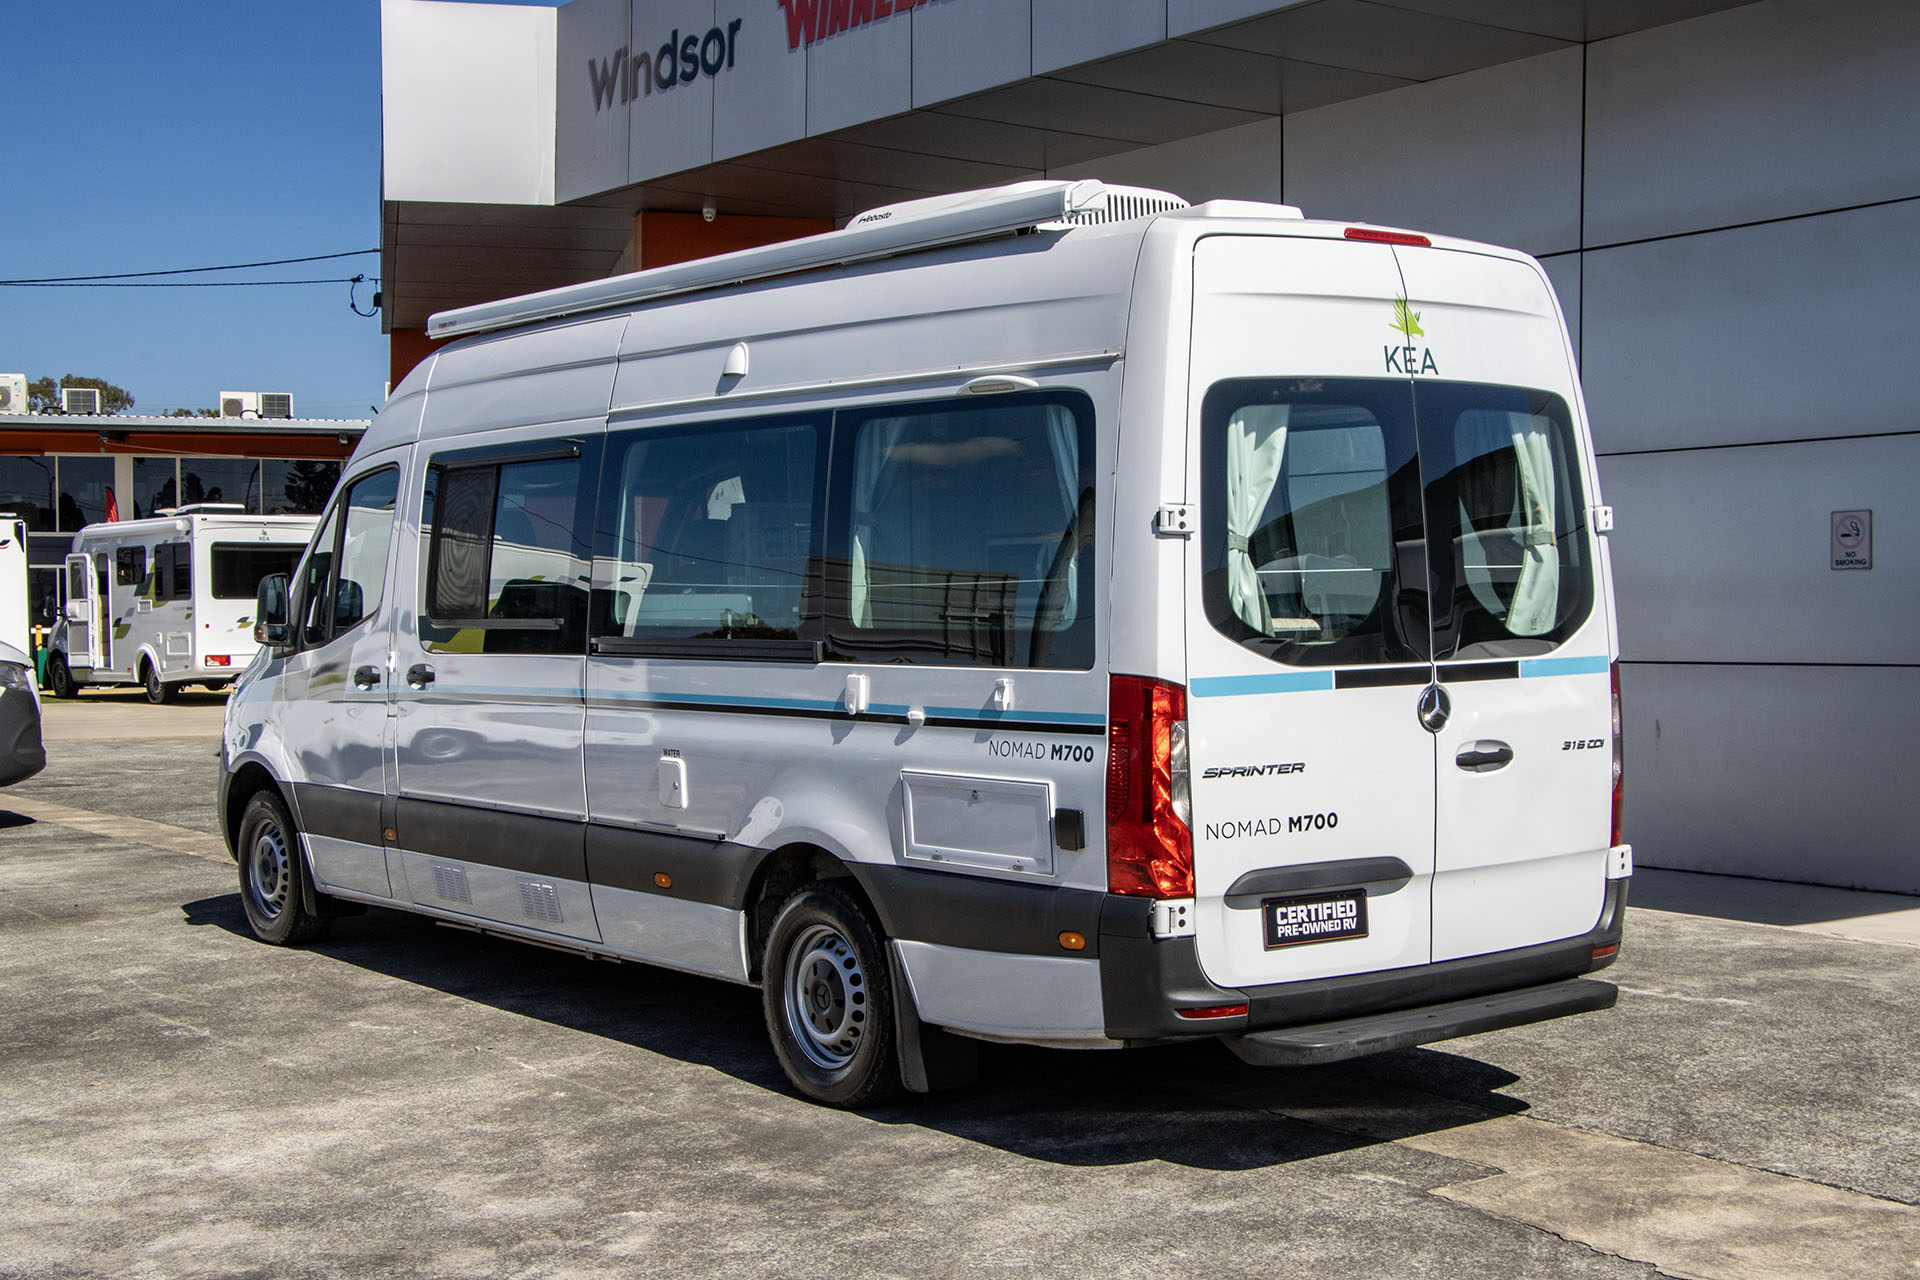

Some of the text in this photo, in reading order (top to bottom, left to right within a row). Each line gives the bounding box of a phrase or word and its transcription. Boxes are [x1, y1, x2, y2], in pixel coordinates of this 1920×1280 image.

[588, 18, 742, 113] Windsor
[1384, 345, 1439, 375] KEA
[1835, 558, 1867, 566] SMOKING
[662, 748, 680, 758] WATER
[988, 740, 1094, 762] NOMAD M700
[1202, 762, 1306, 779] SPRINTER
[1206, 812, 1338, 840] NOMAD M700
[1276, 900, 1357, 926] CERTIFIED
[1277, 917, 1357, 938] PRE-OWNED RV
